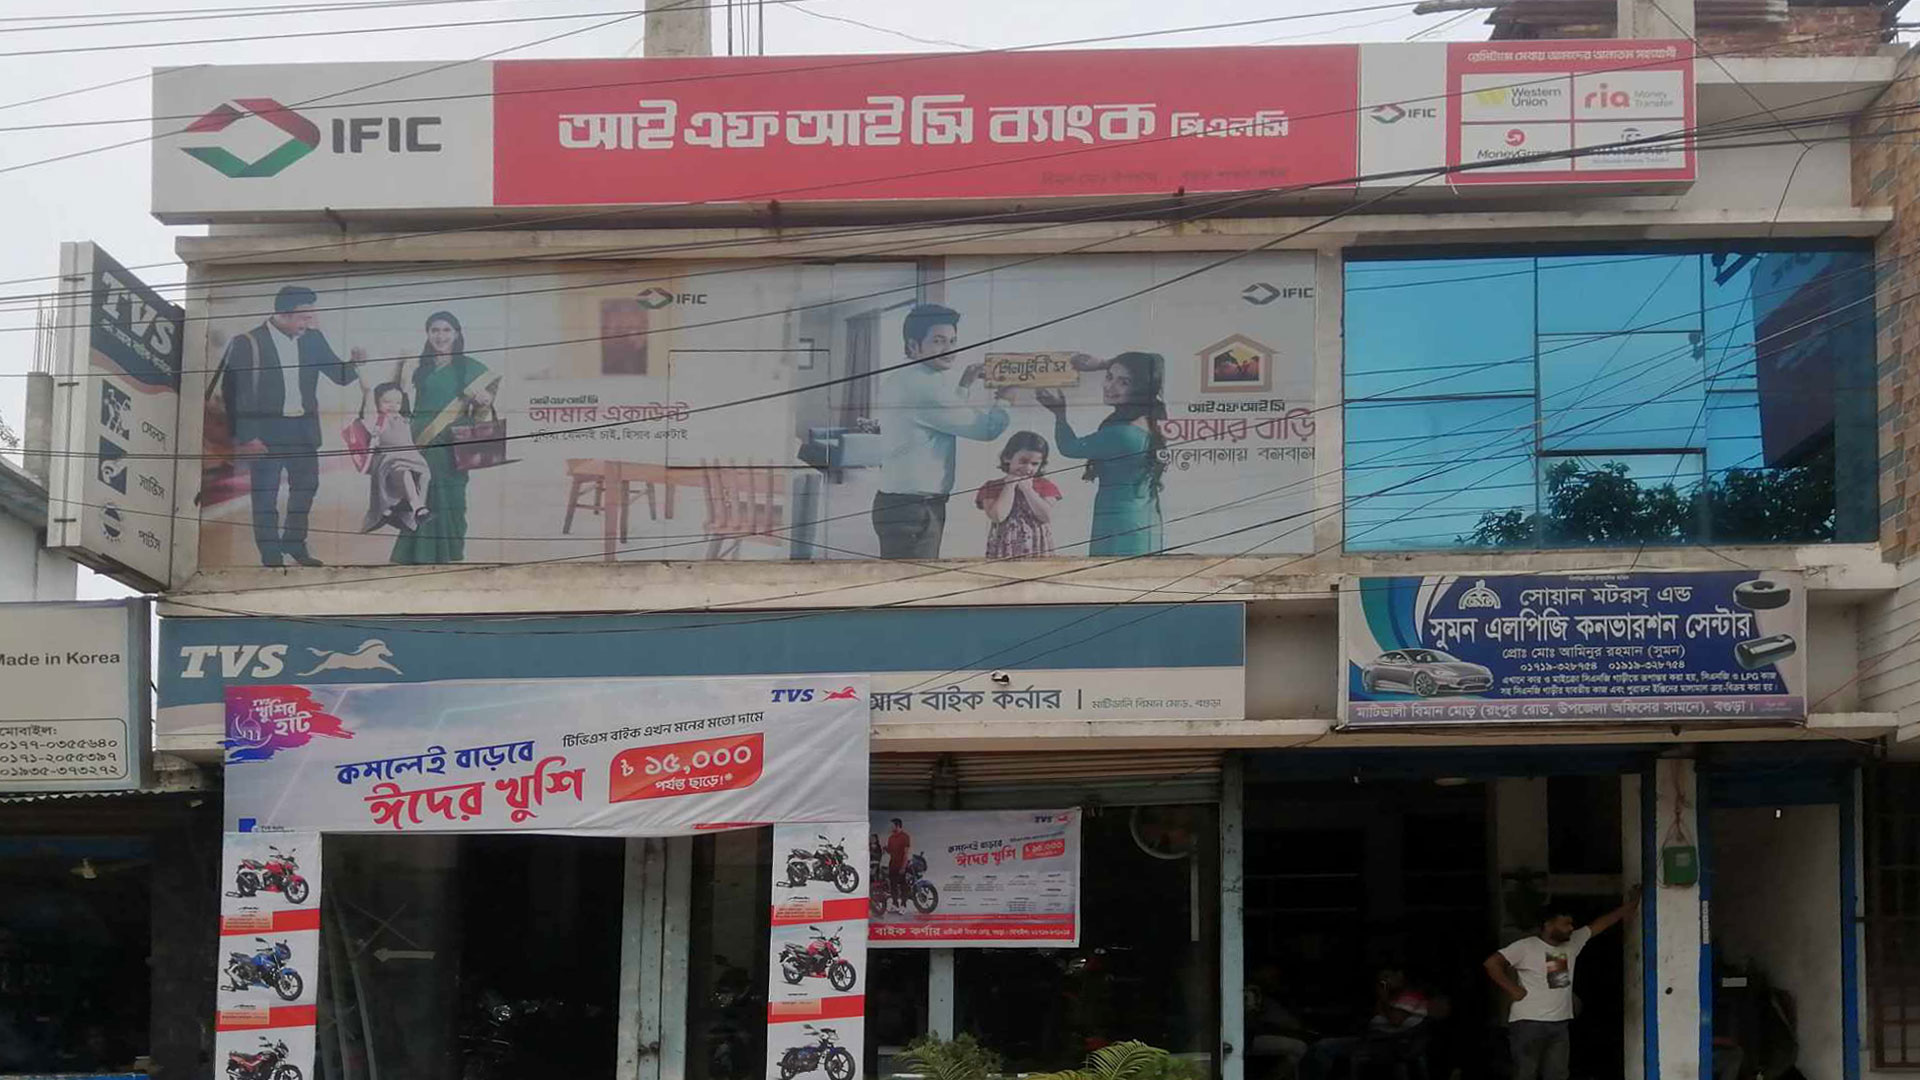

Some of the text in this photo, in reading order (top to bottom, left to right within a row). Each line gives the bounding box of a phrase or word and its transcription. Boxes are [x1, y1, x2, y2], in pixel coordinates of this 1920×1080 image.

[1511, 86, 1562, 98] Western
[1511, 97, 1548, 108] Union
[1584, 83, 1630, 109] ria
[1634, 90, 1668, 101] Money
[989, 103, 1157, 145] ব্যাংক
[1171, 110, 1289, 139] পিএলসি
[1408, 108, 1437, 119] IFIC
[332, 116, 442, 155] IFIC
[677, 294, 707, 305] IFIC
[1283, 287, 1314, 298] IFIC
[102, 271, 177, 356] TVS
[529, 402, 691, 424] আমার একাউন্ট
[1157, 407, 1316, 443] আমার বাড়ি
[1256, 446, 1316, 463] বসবাস
[139, 473, 165, 499] সার্ভিস
[1520, 587, 1586, 607] সোয়ান
[1657, 585, 1693, 602] এন্ড
[1429, 605, 1754, 651] সুমন এলপিজি কনভারশন সেন্টার
[45, 653, 61, 665] in
[67, 651, 120, 665] Korea
[180, 644, 288, 679] TVS
[1559, 643, 1603, 660] আমিনুর
[1605, 645, 1644, 659] রহমান
[1647, 644, 1686, 660] (সুমন)
[1741, 672, 1759, 681] LPG
[771, 688, 815, 703] TVS
[921, 685, 985, 713] বাইক
[992, 684, 1063, 711] কর্নার
[256, 700, 297, 724] খুশির
[1411, 702, 1443, 717] বিমান
[1447, 704, 1475, 719] মোড়
[1557, 701, 1607, 716] উপজেলা
[1610, 699, 1659, 715] অফিসের
[273, 710, 313, 736] হাট
[562, 711, 765, 748] টিভিএস বাইক এখন মনের মতো দামে
[335, 740, 535, 785] কমলেই বাড়বে
[644, 745, 752, 775] ১৫,০০০
[364, 756, 586, 830] ঈদের খুশি
[655, 777, 686, 792] পর্যন্ত
[874, 924, 907, 938] বাইক
